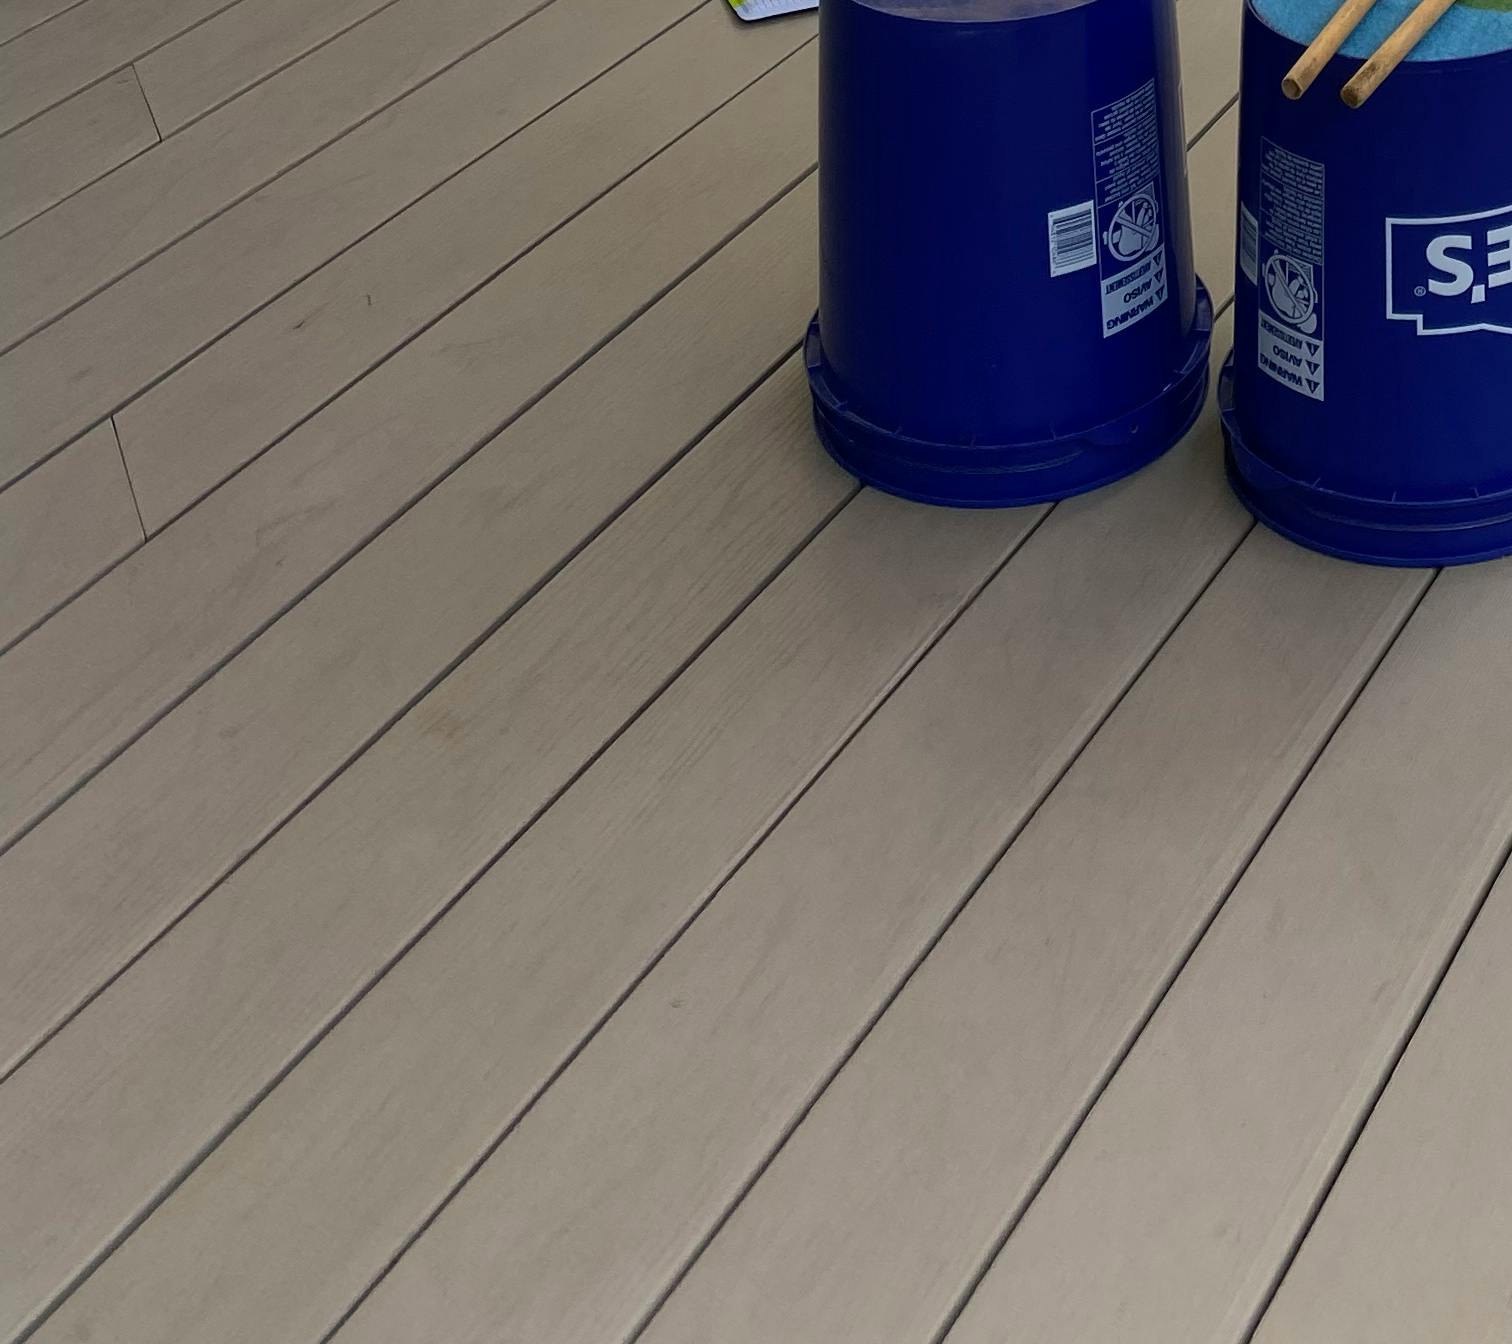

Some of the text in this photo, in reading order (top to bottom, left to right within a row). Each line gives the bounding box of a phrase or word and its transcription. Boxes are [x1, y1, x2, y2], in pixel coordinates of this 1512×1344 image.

[1124, 278, 1152, 303] AVISO
[1106, 295, 1154, 330] WARNING
[1260, 353, 1303, 387] WARNING
[1273, 344, 1302, 367] AVISO
